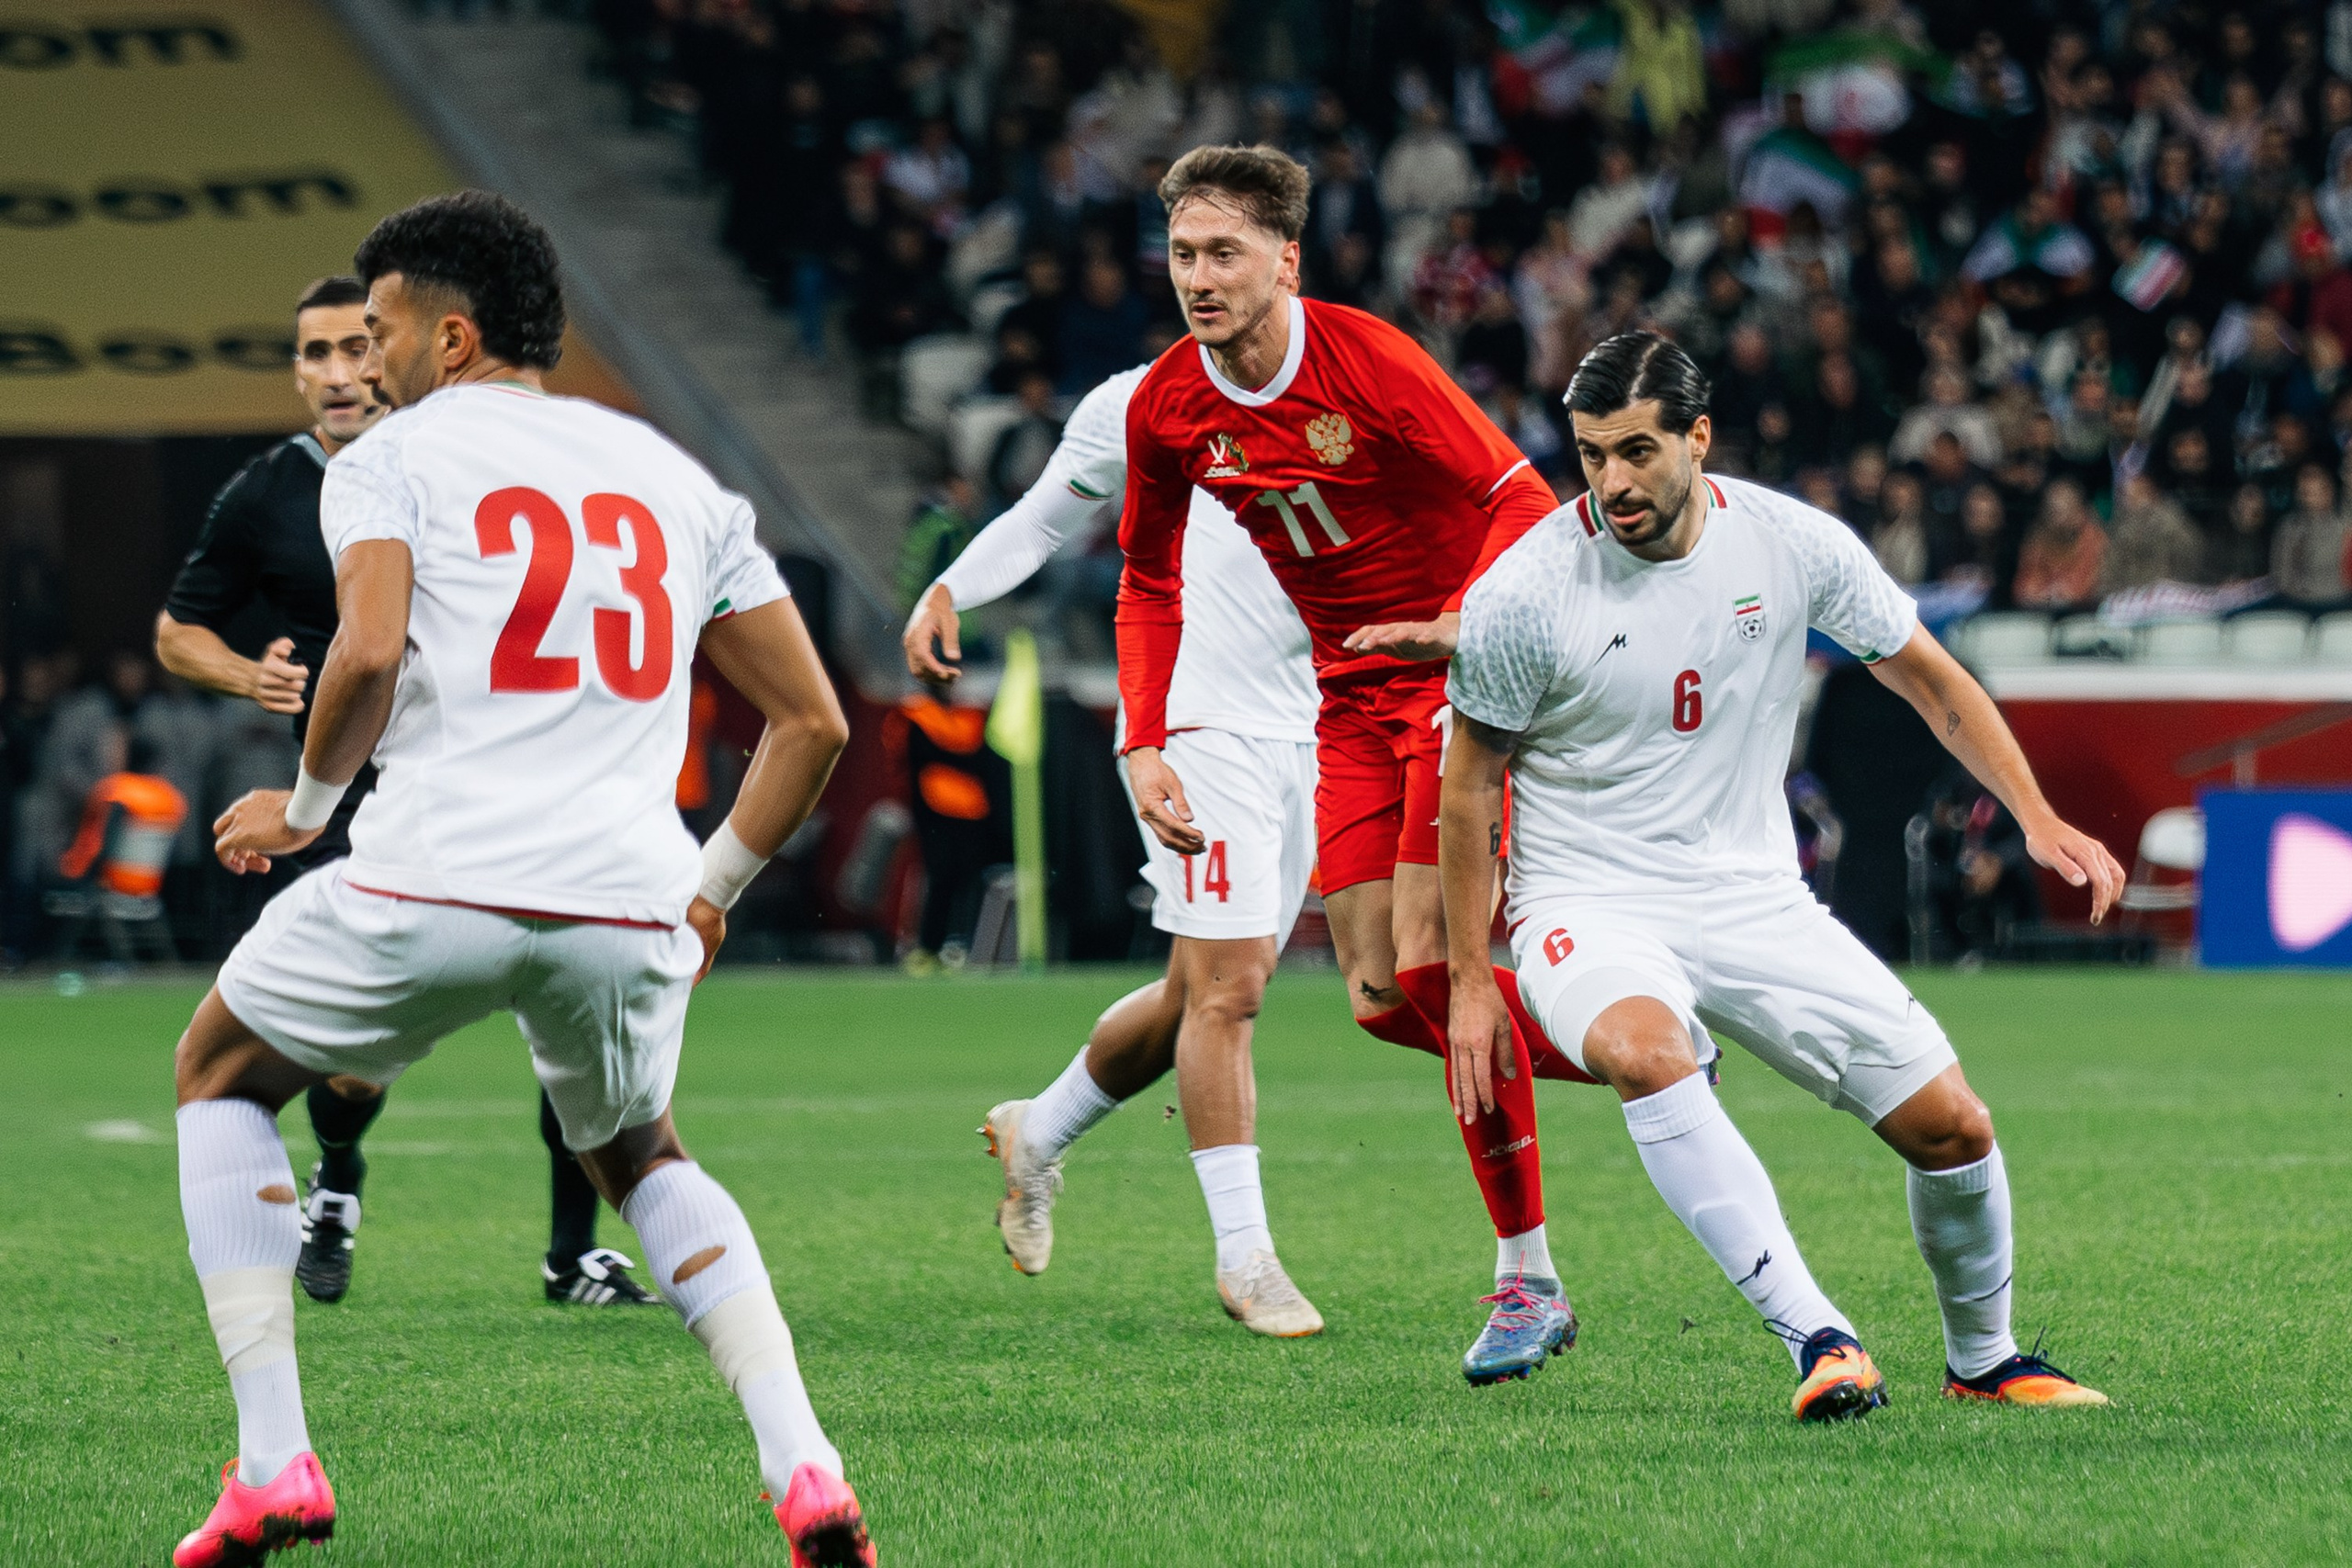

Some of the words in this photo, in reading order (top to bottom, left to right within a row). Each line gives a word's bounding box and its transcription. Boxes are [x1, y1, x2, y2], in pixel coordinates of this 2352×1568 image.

[1255, 480, 1351, 558] 11
[474, 486, 673, 704] 23
[1672, 669, 1703, 733] 6
[1178, 840, 1231, 903] 14
[1544, 928, 1575, 967] 6
